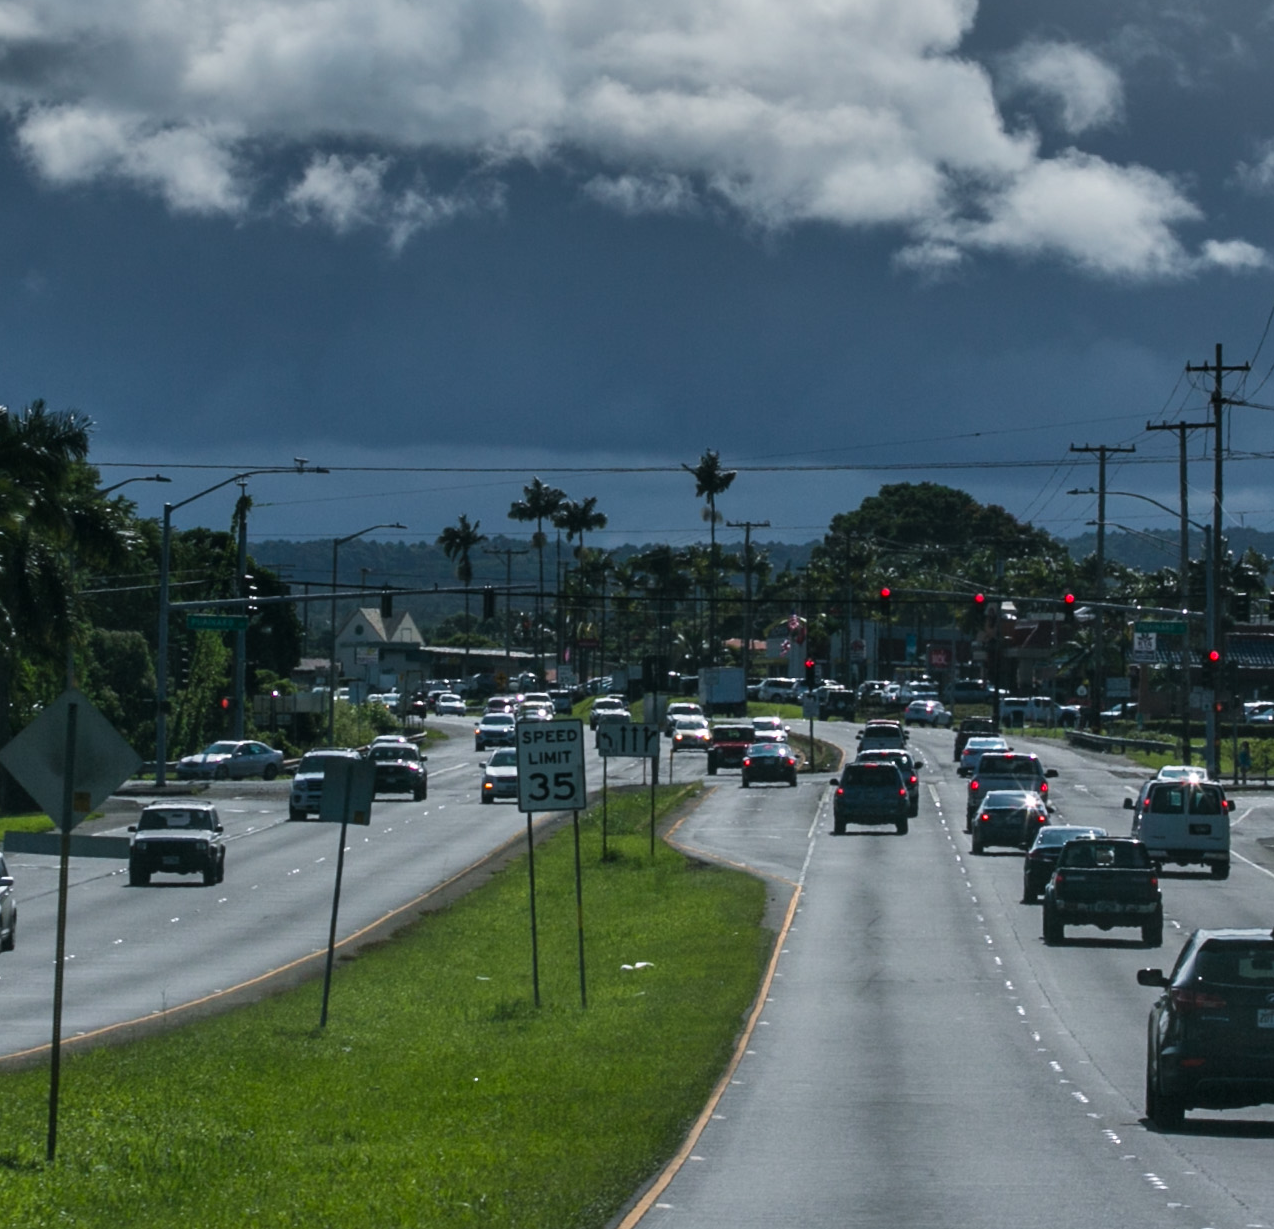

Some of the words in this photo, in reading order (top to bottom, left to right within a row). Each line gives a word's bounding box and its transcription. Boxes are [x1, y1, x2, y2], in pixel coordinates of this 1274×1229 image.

[522, 729, 577, 744] SPEED
[528, 750, 571, 765] LIMIT
[528, 772, 575, 801] 35
